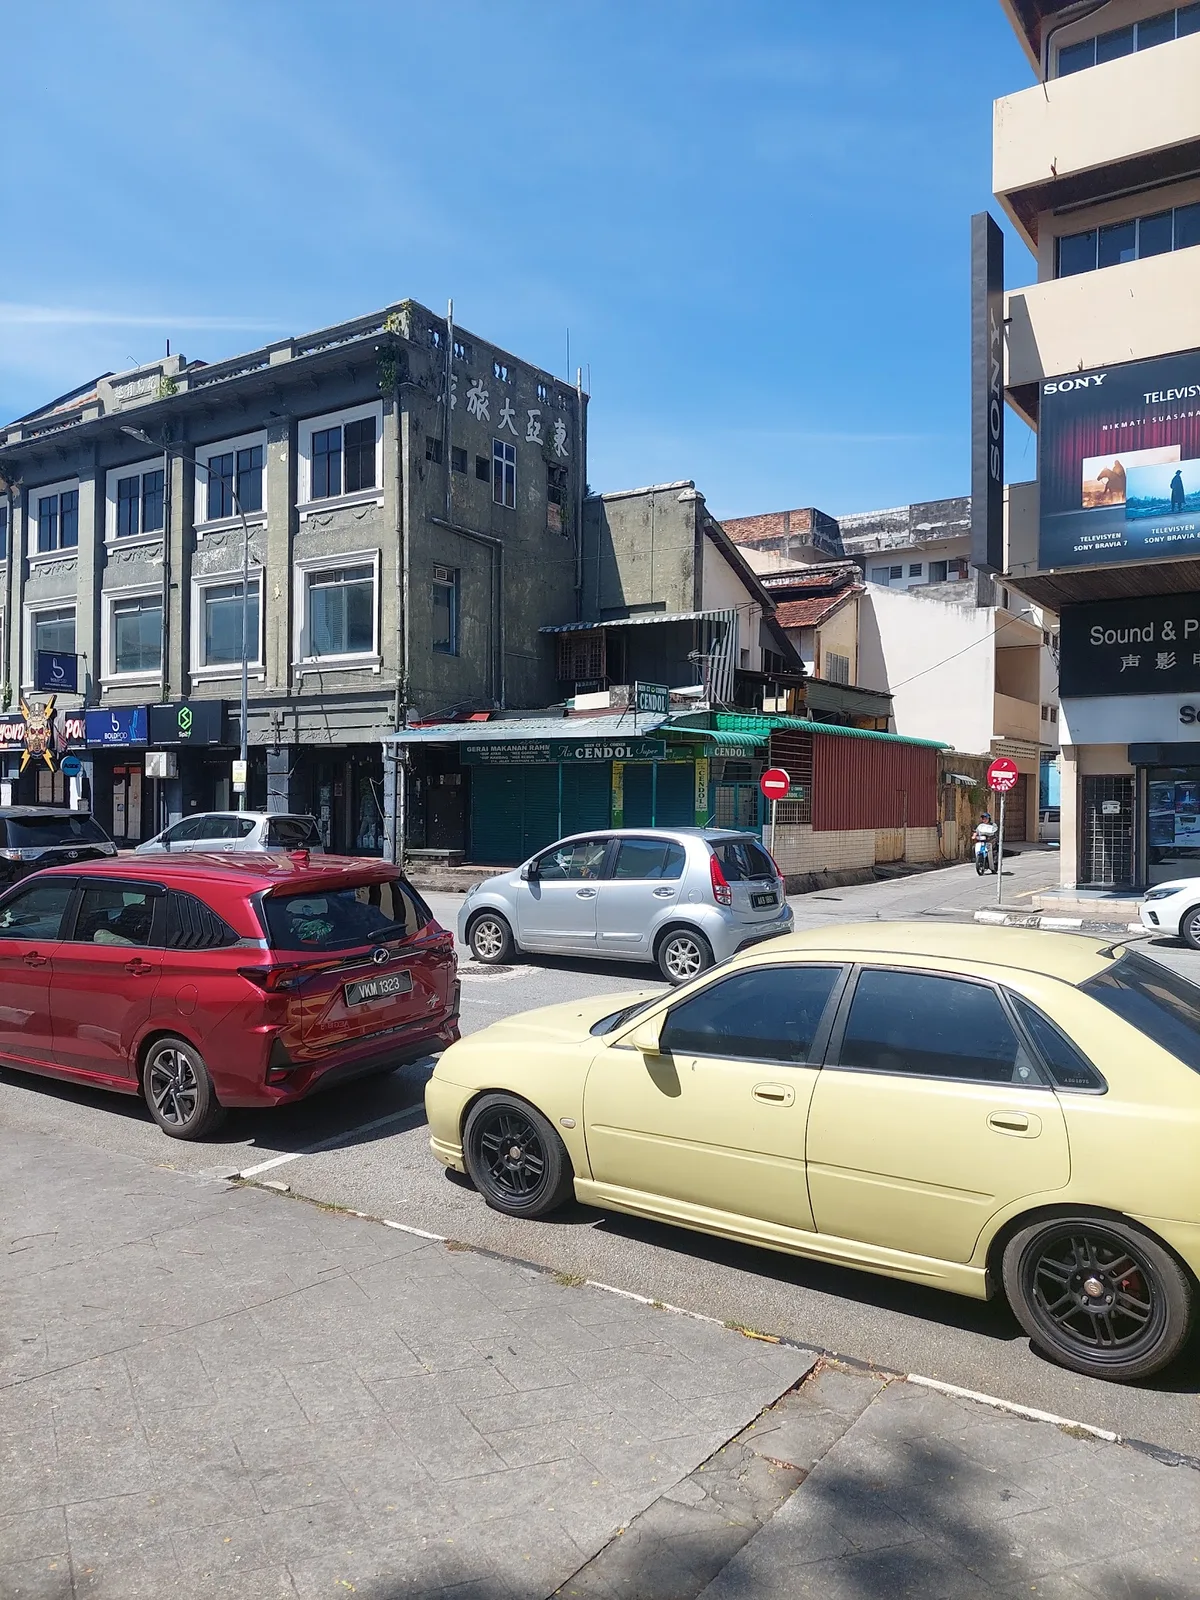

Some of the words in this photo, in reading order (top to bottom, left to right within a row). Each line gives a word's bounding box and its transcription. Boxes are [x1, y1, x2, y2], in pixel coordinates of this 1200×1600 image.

[1043, 373, 1107, 395] SONY
[990, 307, 1000, 482] SONY
[1102, 418, 1146, 431] NIKMATI
[1152, 410, 1200, 423] SUASANA
[1080, 532, 1121, 542] TELEVISYEN
[1151, 524, 1195, 534] TELEVISYEN
[1073, 544, 1093, 552] SONY
[1095, 541, 1121, 549] BRAVIA
[1144, 536, 1165, 544] SONY
[1167, 533, 1195, 541] BRAVIA
[1090, 621, 1154, 646] Sound
[1161, 620, 1177, 641] &
[640, 693, 666, 711] CENDOL
[574, 746, 634, 759] CENDOL
[635, 743, 658, 757] Super
[714, 747, 746, 757] CENDOL
[698, 770, 706, 804] CENDOL
[358, 984, 378, 998] VKM
[379, 978, 400, 993] 1323
